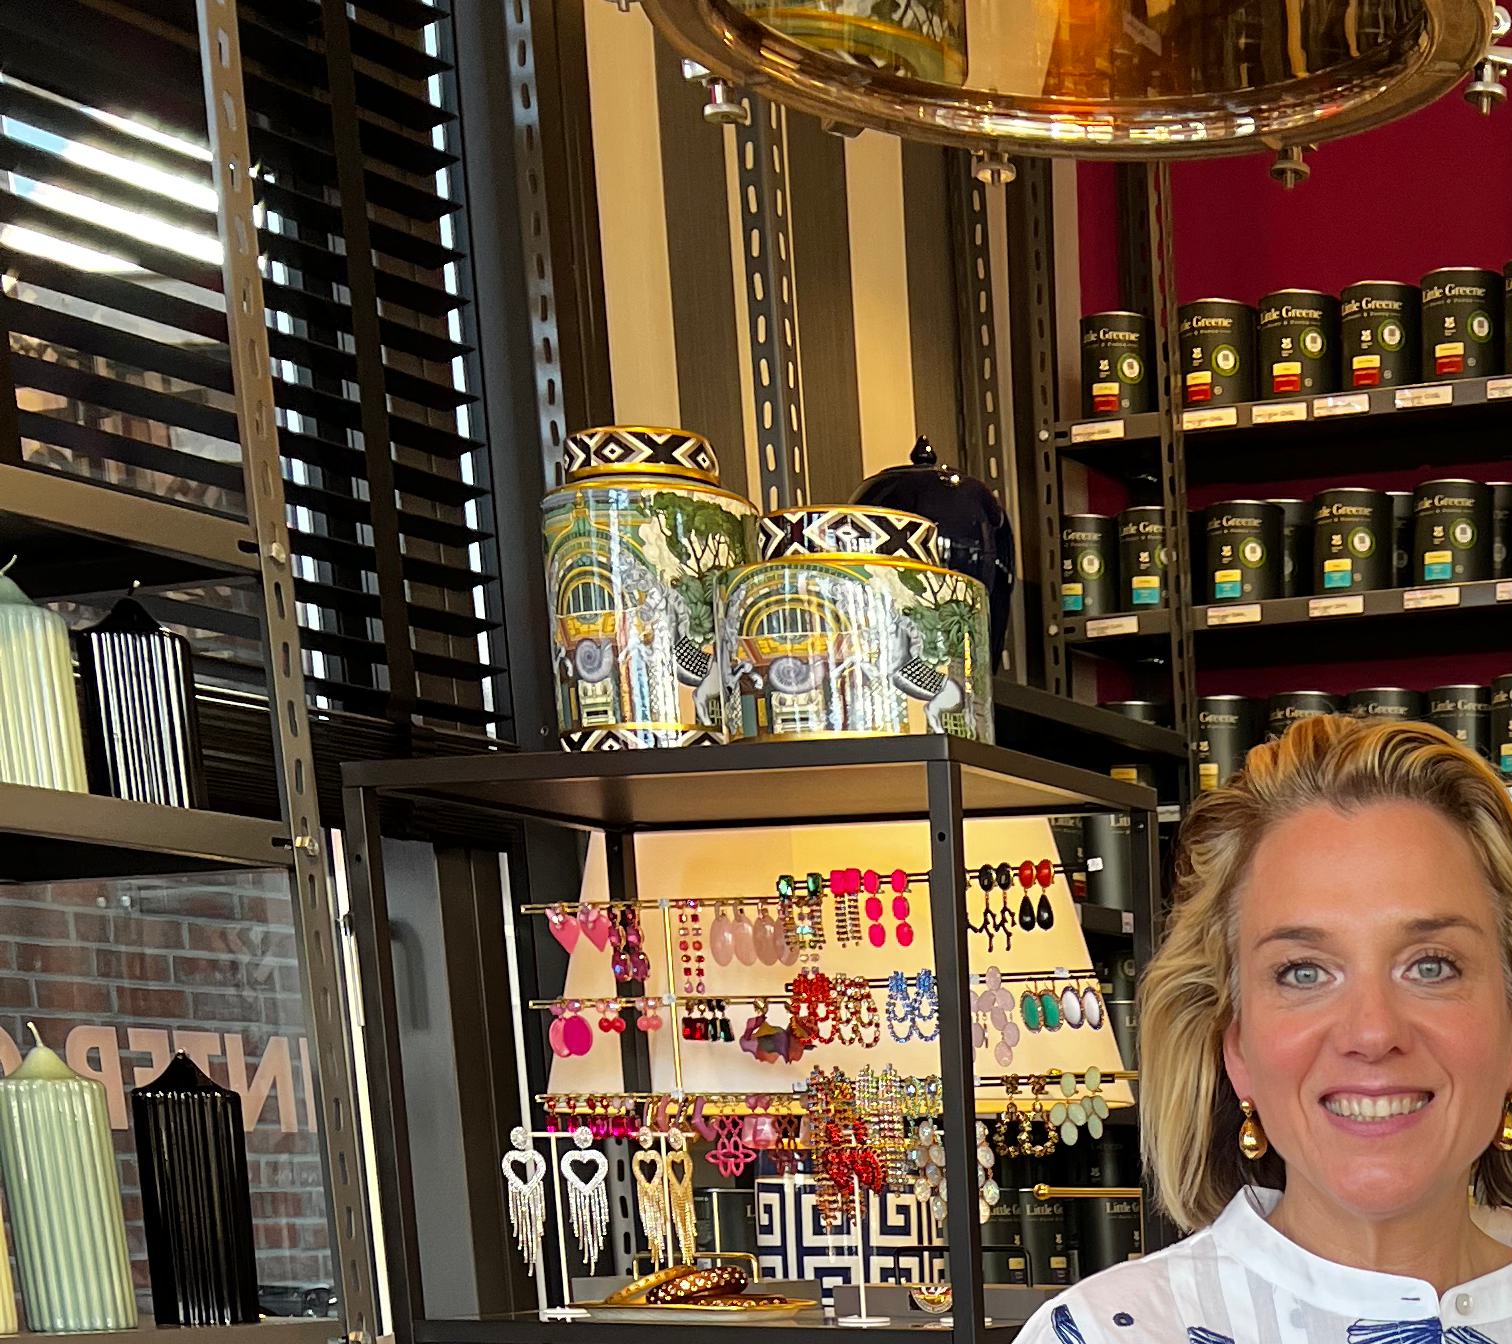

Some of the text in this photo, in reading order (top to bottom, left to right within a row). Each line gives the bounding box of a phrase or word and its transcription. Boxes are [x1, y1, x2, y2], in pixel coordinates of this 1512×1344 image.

[1444, 283, 1487, 297] Greene
[1362, 297, 1403, 312] Greene
[1281, 305, 1323, 320] Greene
[1192, 315, 1233, 328] Greene
[1099, 328, 1140, 342] Greene
[1434, 494, 1475, 507] Greene
[1332, 503, 1373, 516] Greene
[1222, 515, 1262, 528] Greene
[1199, 711, 1239, 724] Greene
